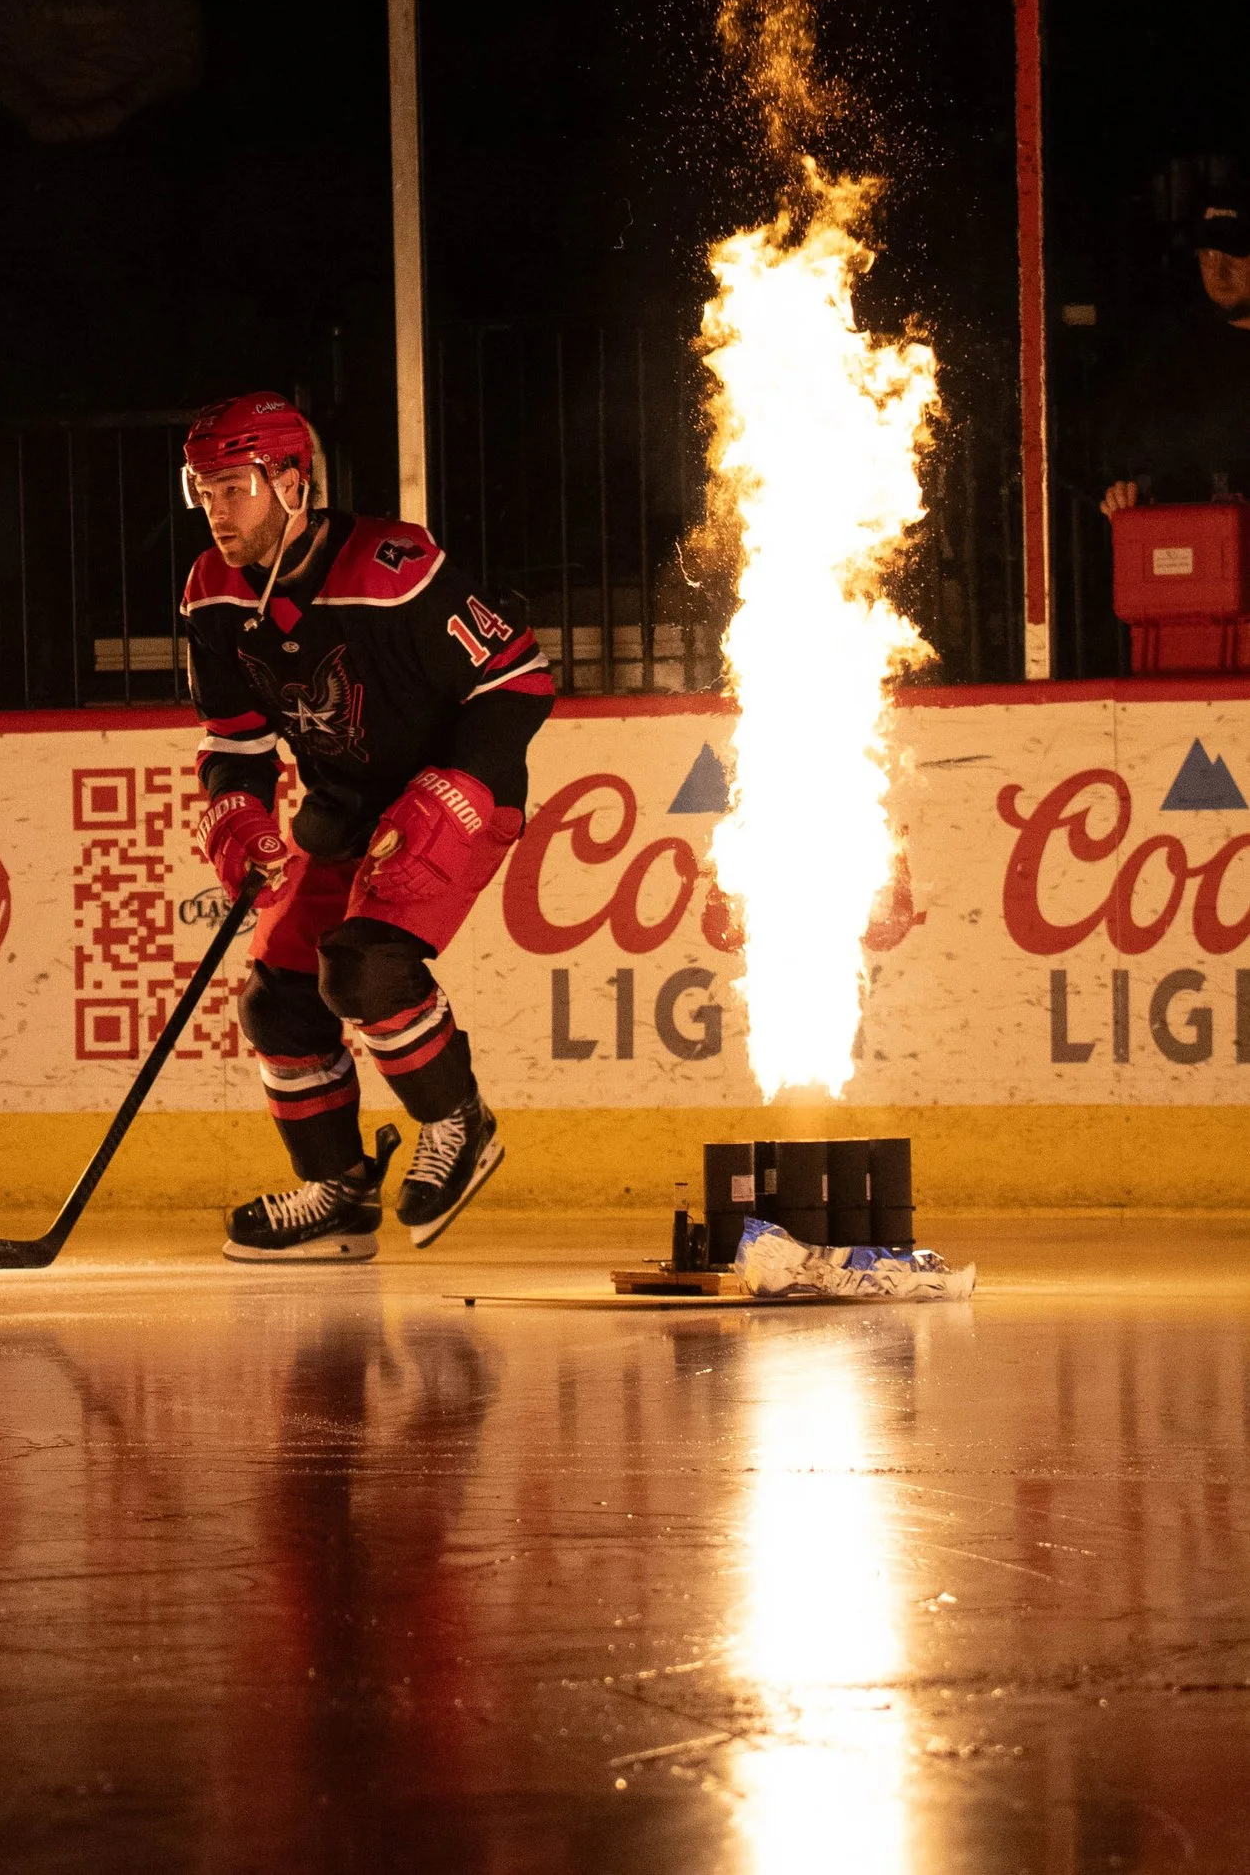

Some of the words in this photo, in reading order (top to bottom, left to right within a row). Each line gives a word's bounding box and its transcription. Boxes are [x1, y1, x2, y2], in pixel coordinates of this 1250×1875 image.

[447, 595, 513, 667] 14
[196, 795, 247, 861] RIOR
[408, 771, 483, 835] ARRIOR
[1051, 967, 1250, 1065] LIG
